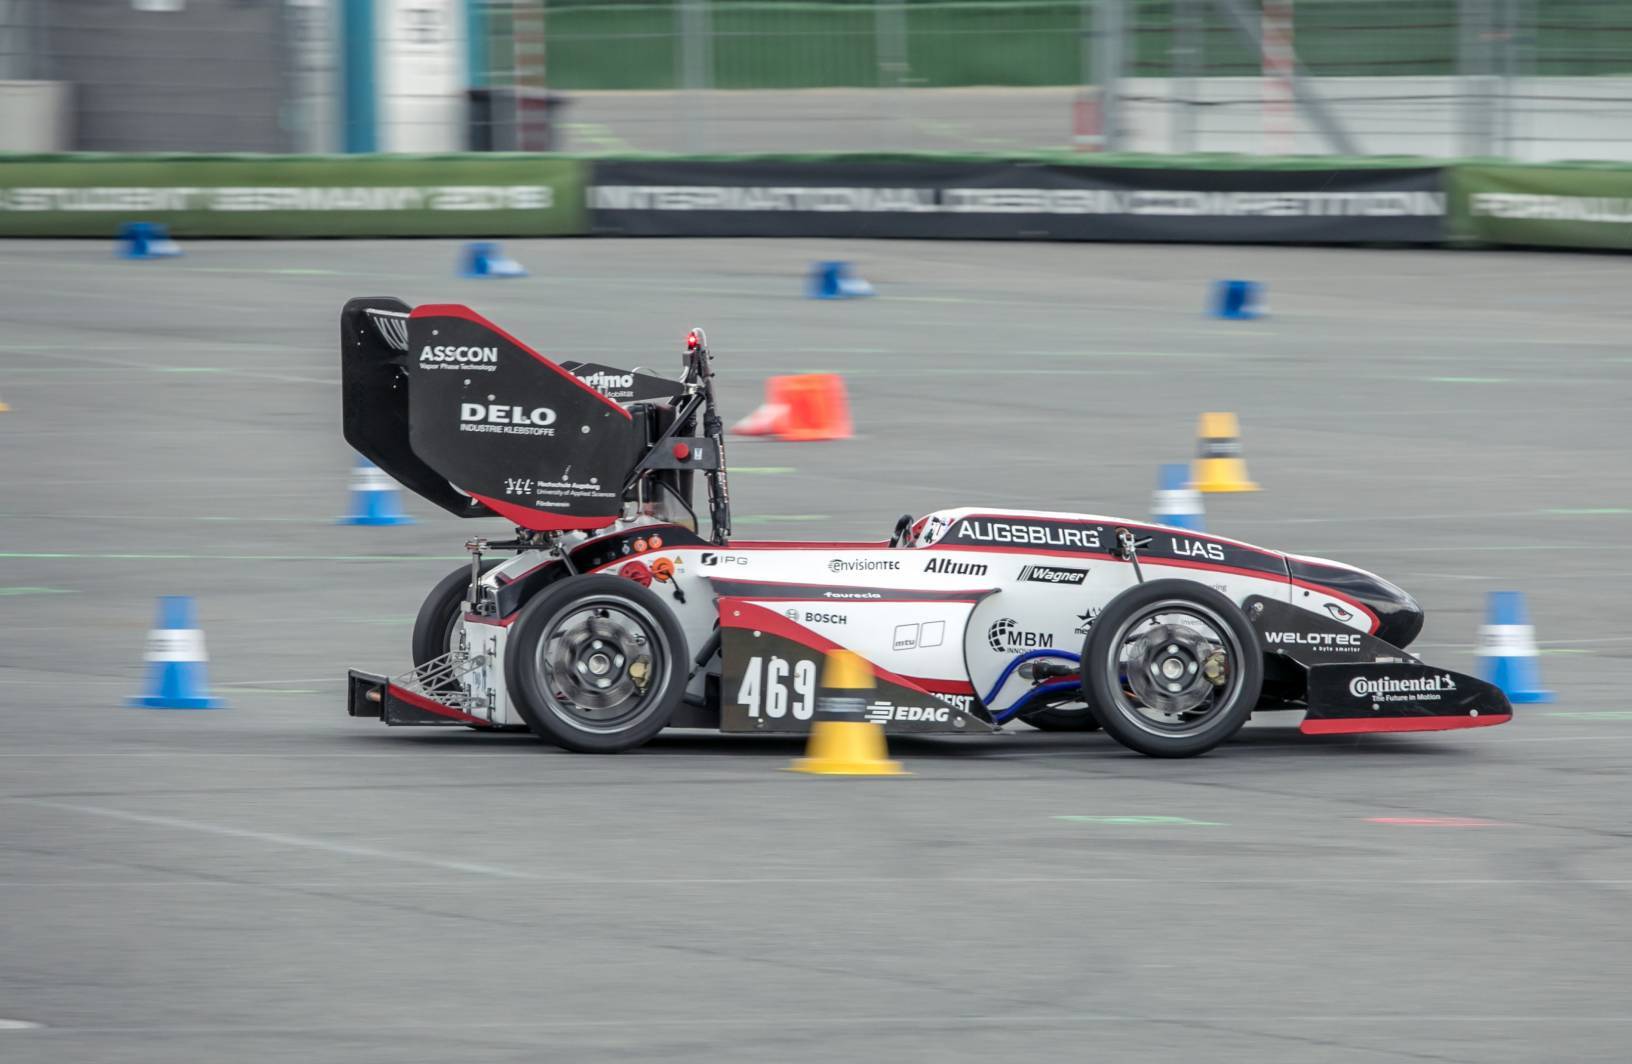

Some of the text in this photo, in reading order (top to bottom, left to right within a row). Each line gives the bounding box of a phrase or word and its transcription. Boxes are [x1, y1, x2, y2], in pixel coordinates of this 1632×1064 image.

[419, 345, 498, 363] ASSCON
[440, 362, 460, 371] Phase
[460, 363, 498, 373] Technology
[460, 402, 557, 426] DELO
[460, 423, 556, 437] INDUSTRIE KLEBSTOFFE
[591, 490, 617, 498] Sciences
[957, 520, 1101, 549] AUGSBURG
[1171, 536, 1226, 561] UAS
[719, 555, 749, 566] IPG
[923, 557, 989, 577] Altium
[1030, 567, 1086, 584] Wagner
[823, 590, 882, 599] faurecia
[804, 611, 848, 626] BOSCH
[895, 638, 916, 647] mtu
[1006, 630, 1054, 649] MBM
[1318, 645, 1334, 653] byte
[737, 656, 817, 720] 469
[1349, 675, 1441, 698] Continental
[1371, 694, 1386, 702] The
[1385, 693, 1409, 702] Future
[1416, 693, 1442, 701] Motion
[894, 706, 950, 722] EDAG
